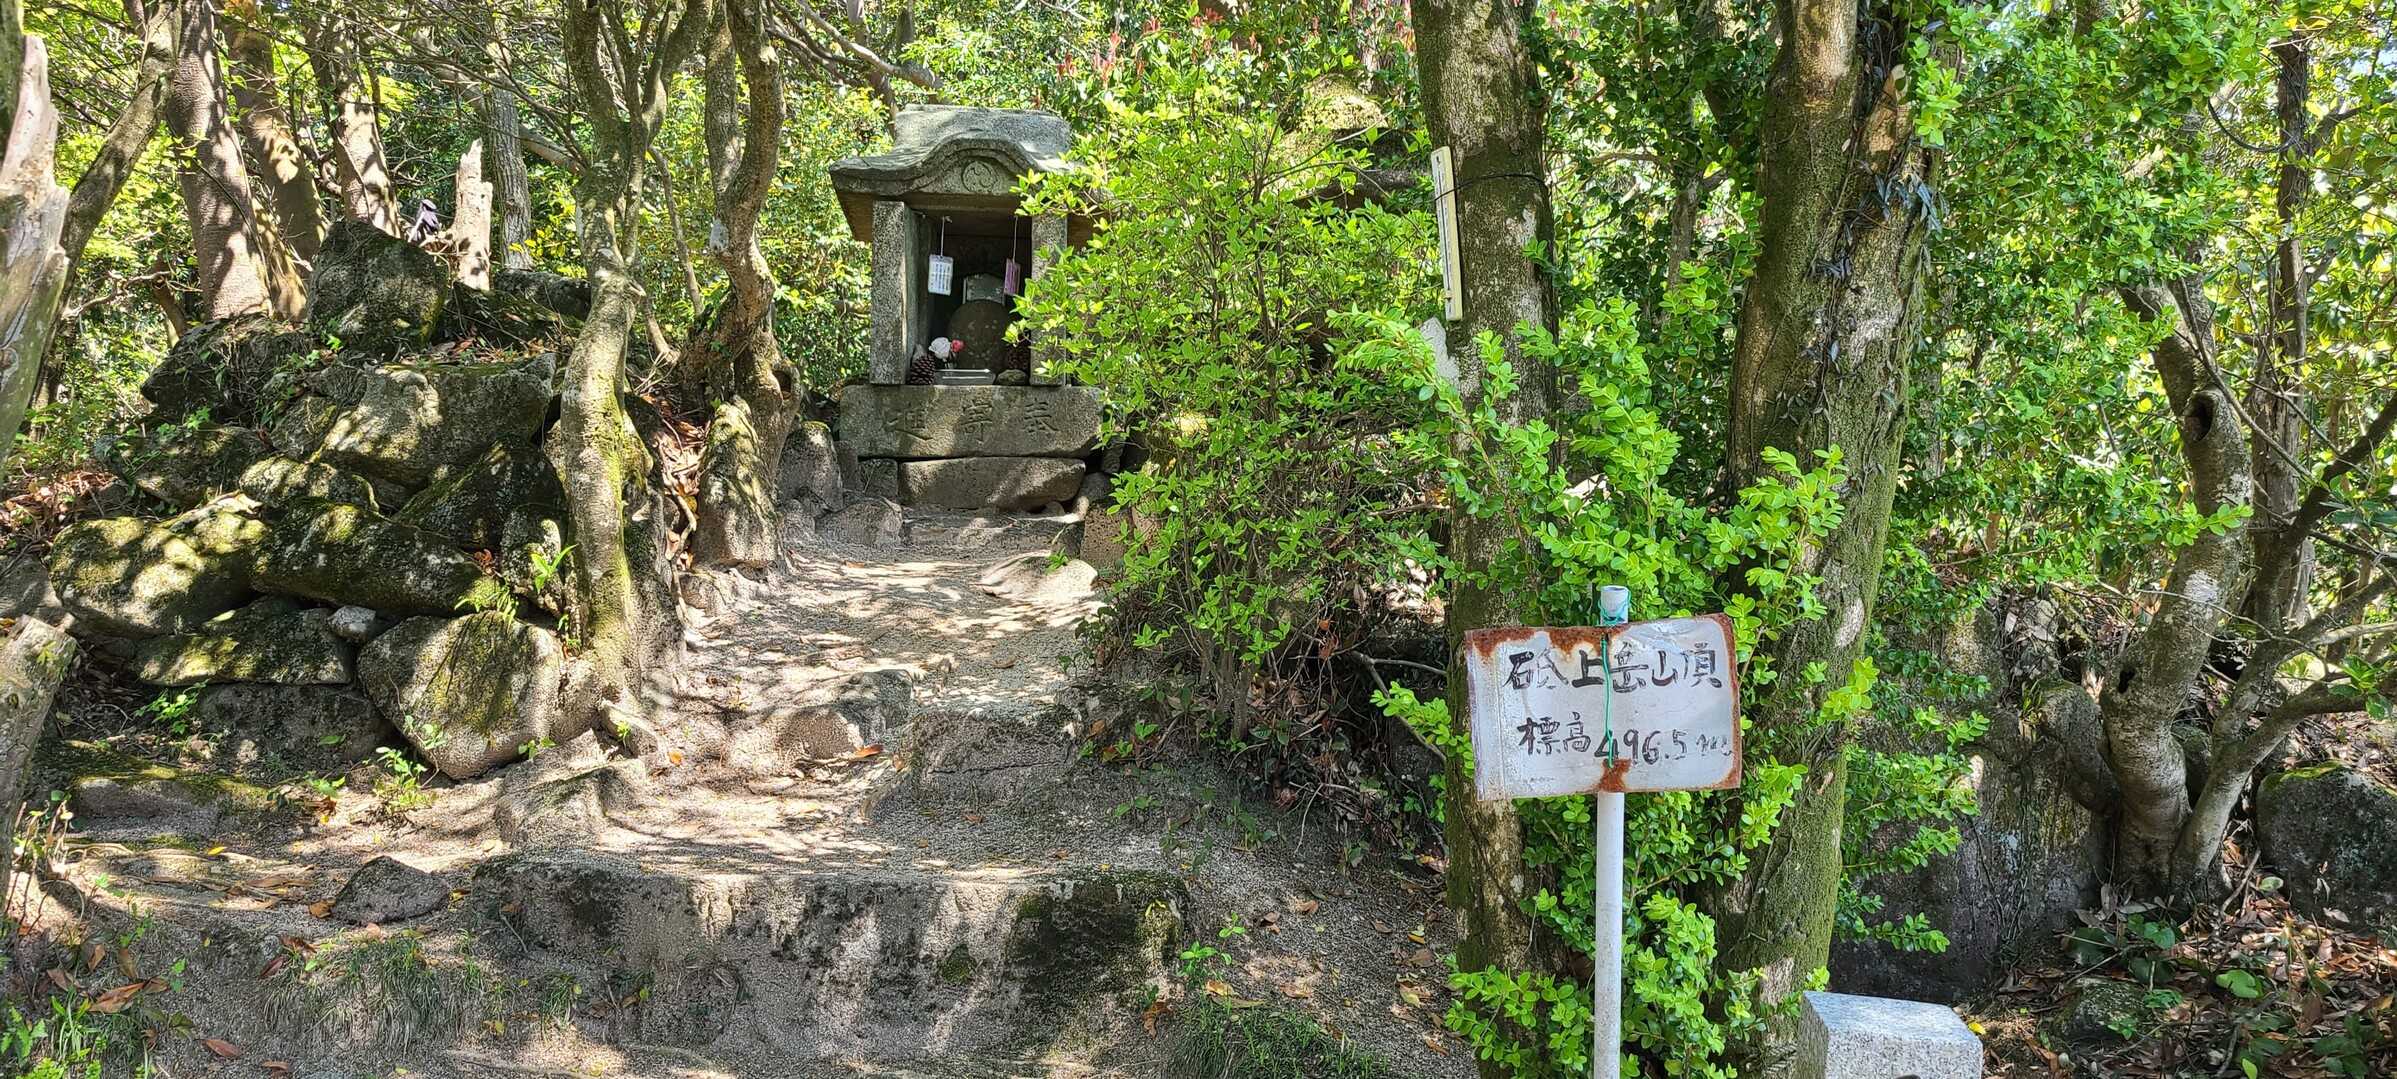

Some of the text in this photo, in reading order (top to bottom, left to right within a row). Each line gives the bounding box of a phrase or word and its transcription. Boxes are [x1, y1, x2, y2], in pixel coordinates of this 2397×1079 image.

[1503, 642, 1723, 694] 砥上岳山頂
